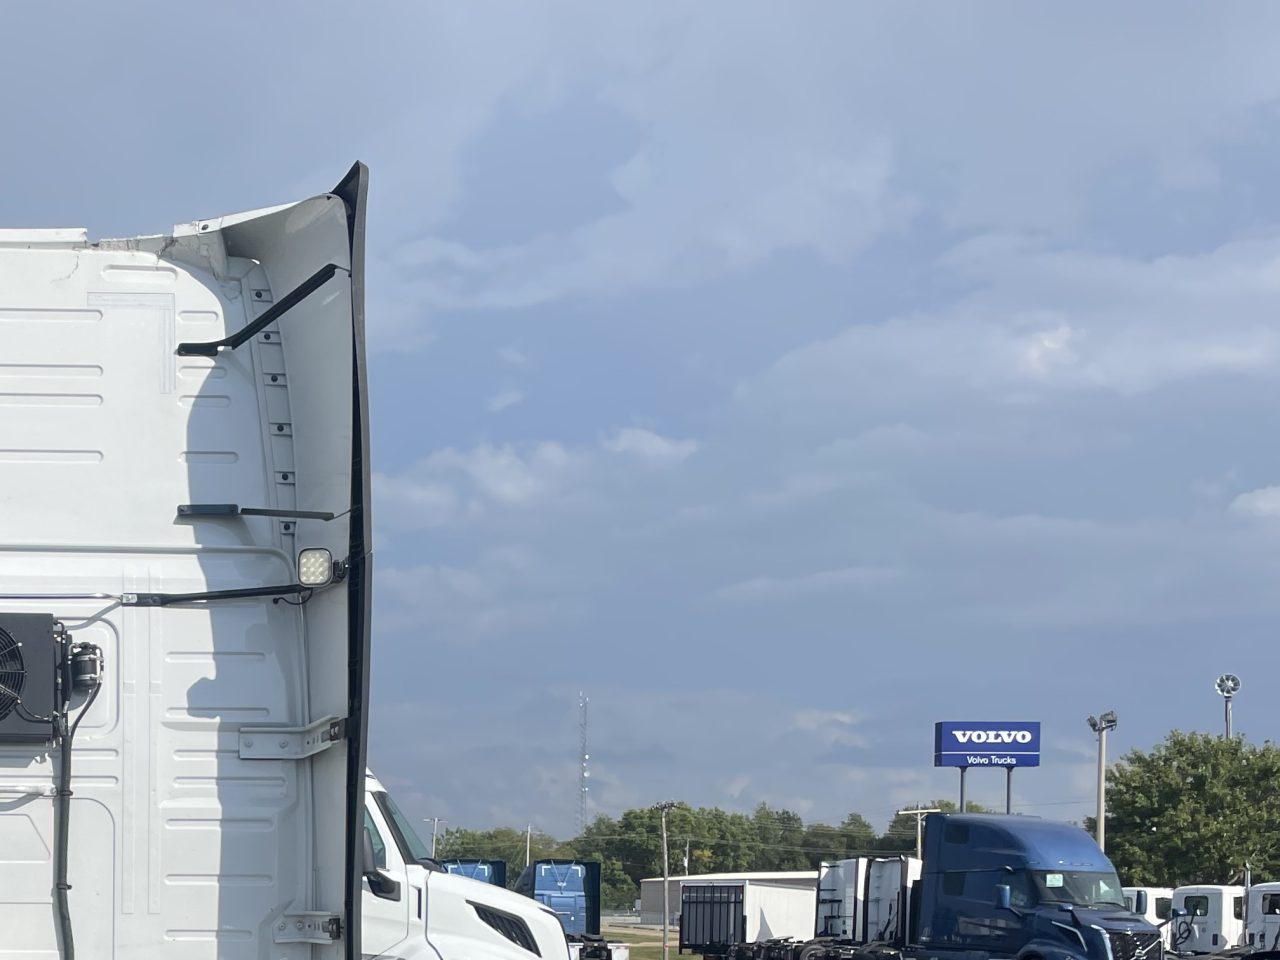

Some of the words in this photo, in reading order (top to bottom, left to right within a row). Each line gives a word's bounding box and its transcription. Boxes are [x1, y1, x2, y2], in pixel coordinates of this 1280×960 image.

[952, 730, 1032, 743] VOLVO
[967, 755, 989, 764] Volvo
[991, 755, 1016, 764] Trucks
